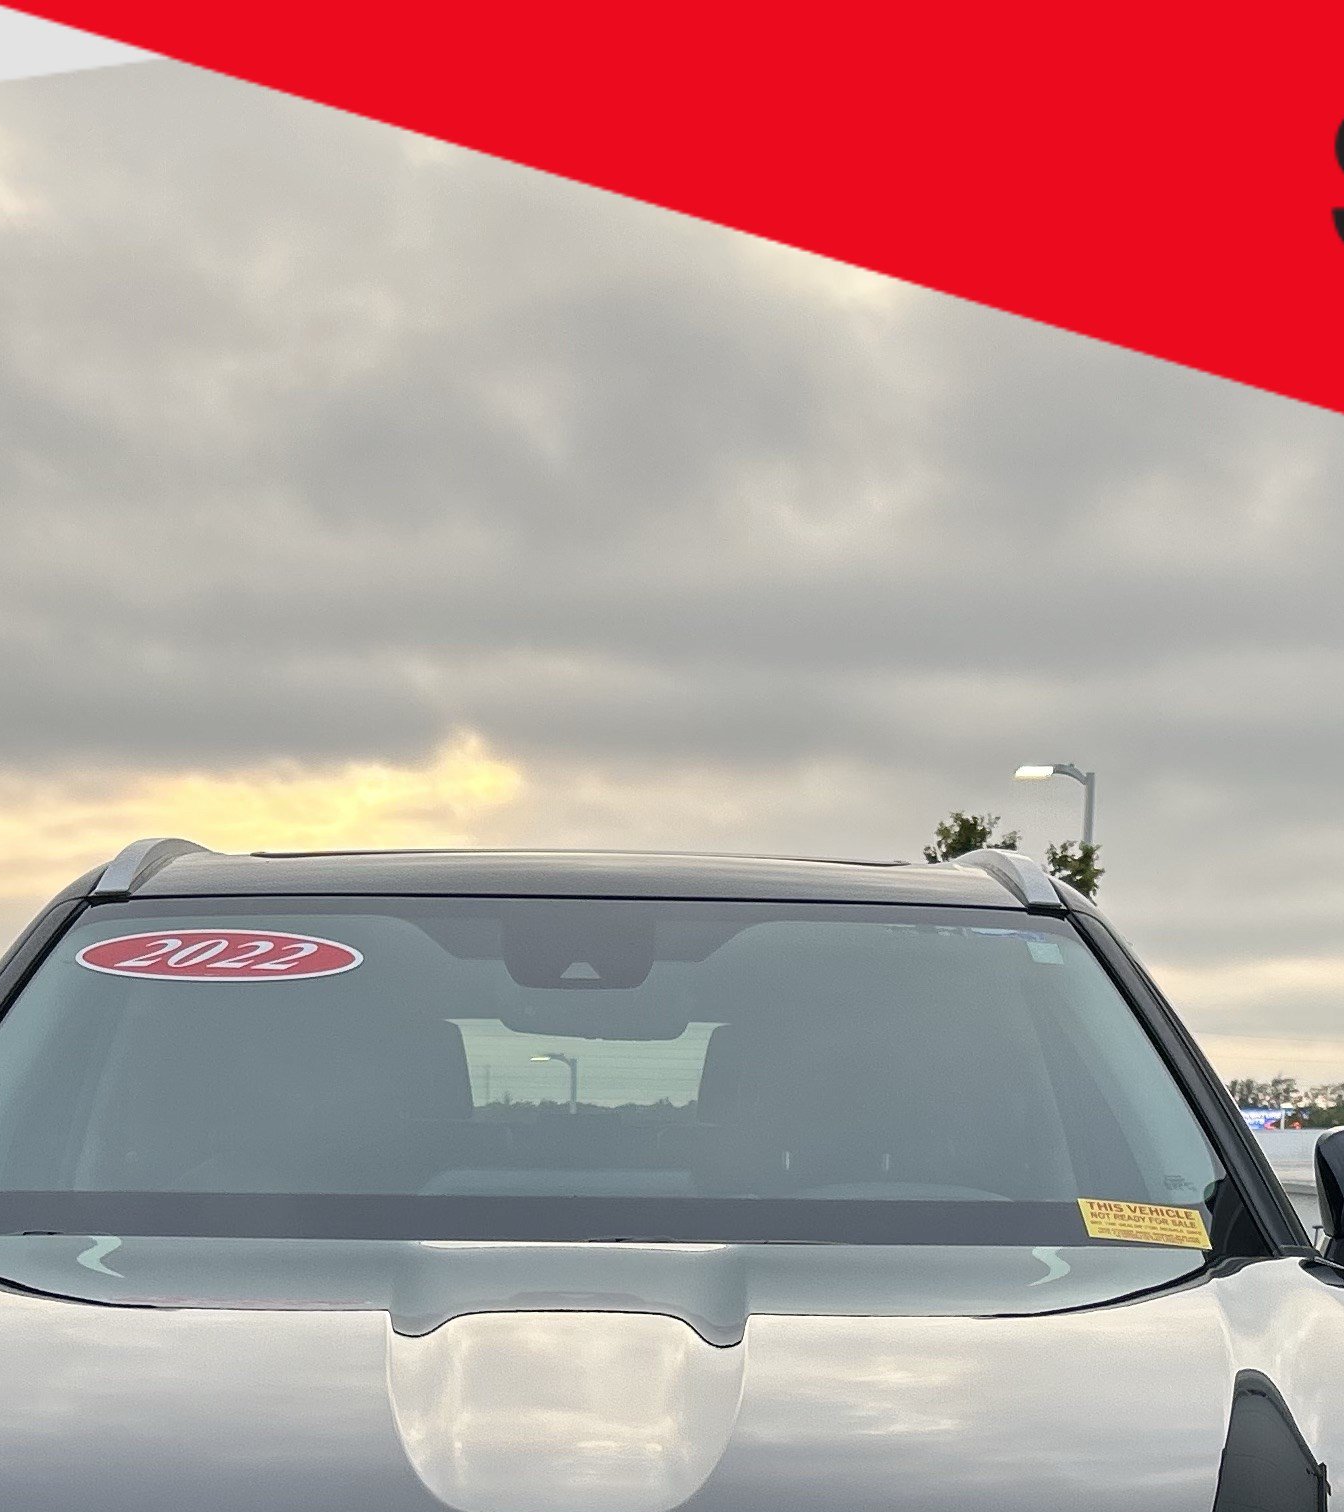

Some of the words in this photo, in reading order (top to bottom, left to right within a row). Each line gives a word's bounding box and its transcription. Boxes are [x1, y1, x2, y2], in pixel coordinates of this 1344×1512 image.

[114, 938, 318, 970] 2022
[1086, 1201, 1124, 1213] THIS
[1126, 1204, 1196, 1221] VEHICLE
[1090, 1211, 1111, 1221] NOT
[1113, 1213, 1146, 1224] READY
[1148, 1216, 1169, 1226] FOR
[1171, 1219, 1197, 1229] SALE
